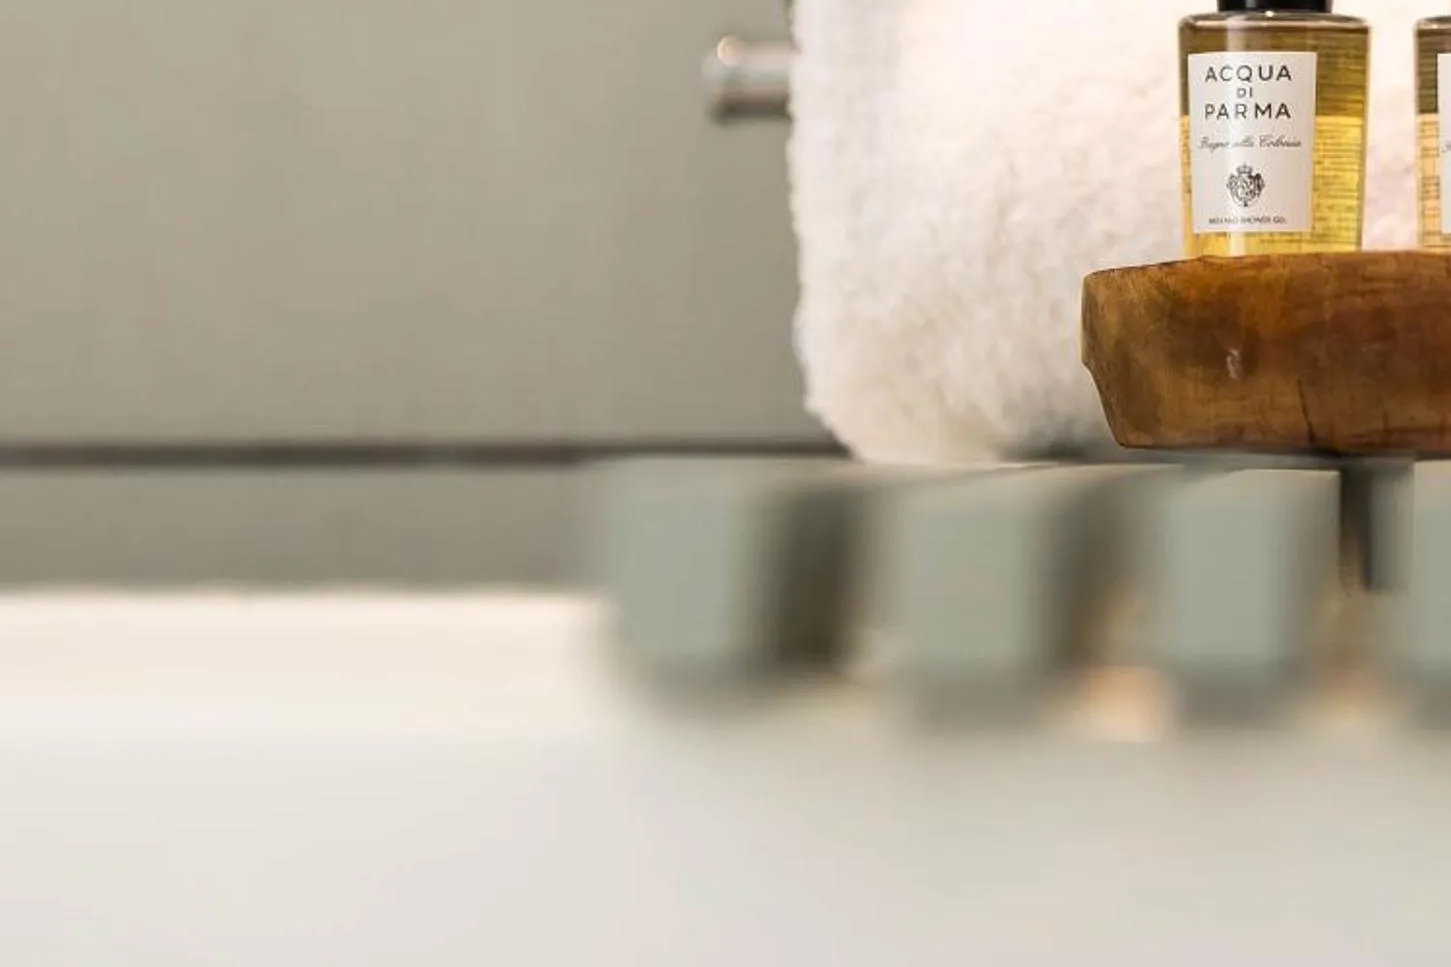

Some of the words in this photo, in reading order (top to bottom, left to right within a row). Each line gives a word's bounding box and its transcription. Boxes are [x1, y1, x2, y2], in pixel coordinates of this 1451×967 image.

[1205, 64, 1292, 82] ACQUA
[1236, 87, 1253, 99] DI
[1204, 103, 1292, 120] PARMA
